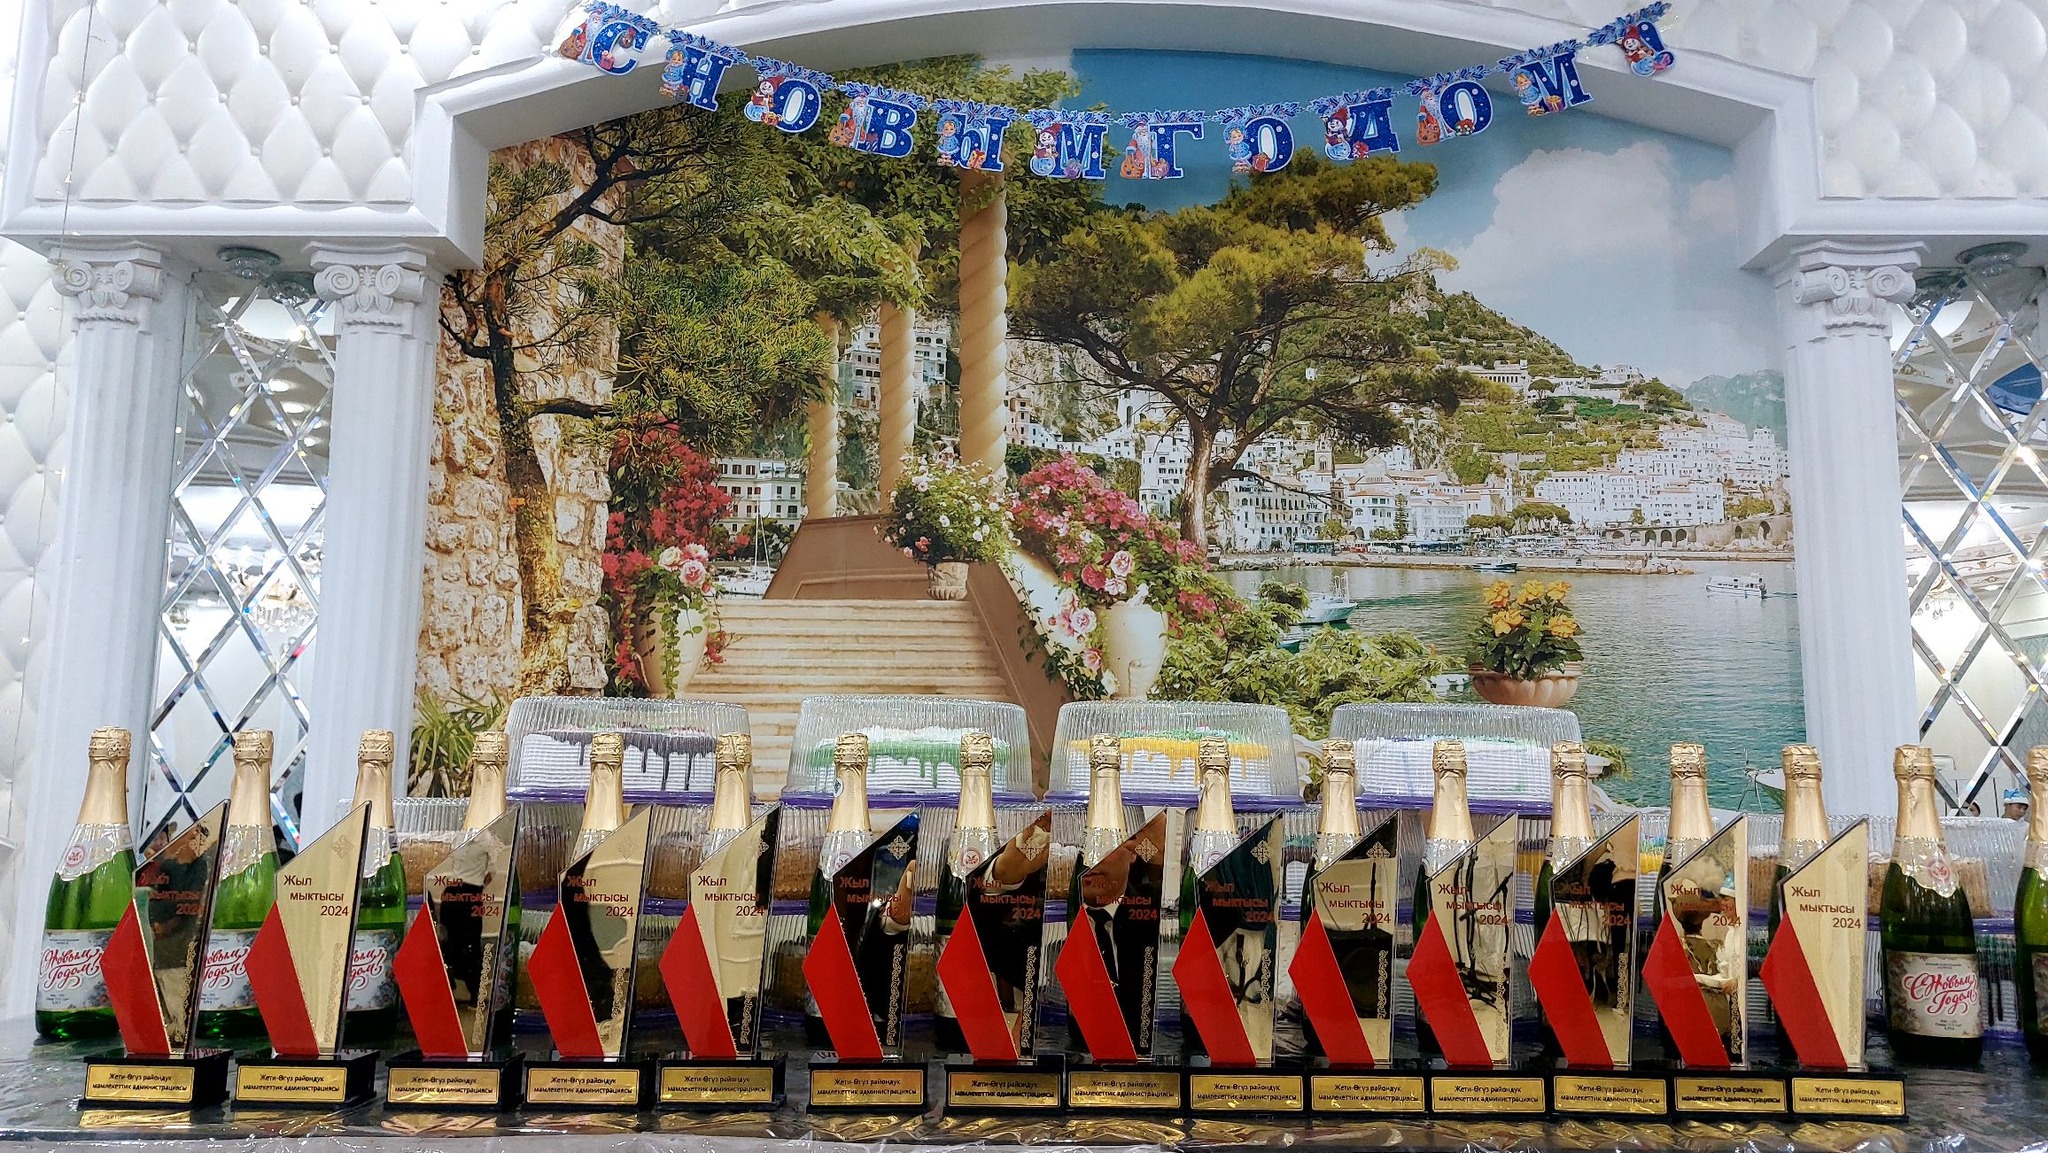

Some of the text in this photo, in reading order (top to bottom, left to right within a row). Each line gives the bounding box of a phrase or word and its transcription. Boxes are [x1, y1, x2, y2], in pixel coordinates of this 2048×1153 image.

[284, 875, 312, 886] Жыл
[434, 875, 463, 886] Жыл
[567, 876, 597, 887] Жыл
[698, 875, 727, 887] Жыл
[840, 877, 869, 888] Жыл
[972, 877, 1002, 888] Жыл
[1321, 882, 1350, 894] Жыл
[1438, 884, 1467, 895] Жыл
[1671, 884, 1700, 896] Жыл
[1791, 886, 1820, 898] Жыл
[290, 892, 344, 902] мыктысы
[441, 891, 495, 902] мыктысы
[574, 892, 629, 903] мыктысы
[704, 891, 759, 903] мыктысы
[980, 894, 1036, 904] мыктысы
[1329, 898, 1384, 910] мыктысы
[1800, 903, 1855, 914] мыктысы
[320, 905, 349, 916] 2024
[471, 906, 499, 917] 2024
[606, 906, 634, 917] 2024
[736, 906, 764, 916] 2024
[879, 906, 907, 917] 202
[1012, 908, 1041, 919] 2024
[1128, 909, 1157, 920] 2024
[1245, 911, 1274, 922] 2024
[1362, 913, 1391, 923] 2024
[1479, 915, 1509, 925] 2024
[1602, 915, 1631, 926] 2024
[1713, 916, 1742, 927] 2024
[1832, 918, 1861, 929] 2024
[143, 1074, 172, 1082] райондук
[295, 1074, 324, 1082] райондук
[447, 1076, 476, 1085] райондук
[870, 1078, 900, 1086] райондук
[92, 1083, 187, 1092] мамлекеттик администрациясы
[243, 1083, 340, 1092] мамлекеттик администрациясы
[395, 1085, 493, 1094] мамлекеттик администрациясы
[534, 1086, 632, 1094] мамлекеттик администрациясы
[710, 1085, 766, 1093] администрациясы
[1249, 1083, 1280, 1091] райондук
[1370, 1084, 1400, 1092] райондук
[1490, 1086, 1521, 1094] райондук
[1612, 1086, 1643, 1094] райондук
[1733, 1086, 1763, 1094] райондук
[1850, 1087, 1880, 1095] райондук
[955, 1089, 1054, 1098] мамлекеттик администрациясы
[1116, 1090, 1174, 1098] администрациясы
[1240, 1093, 1297, 1101] администрациясы
[1360, 1094, 1418, 1102] администрациясы
[1439, 1094, 1479, 1102] мамлекеттик
[1561, 1094, 1660, 1103] мамлекеттик администрациясы
[1682, 1095, 1780, 1104] мамлекеттик администрациясы
[1799, 1096, 1898, 1105] мамлекеттик администрациясы
